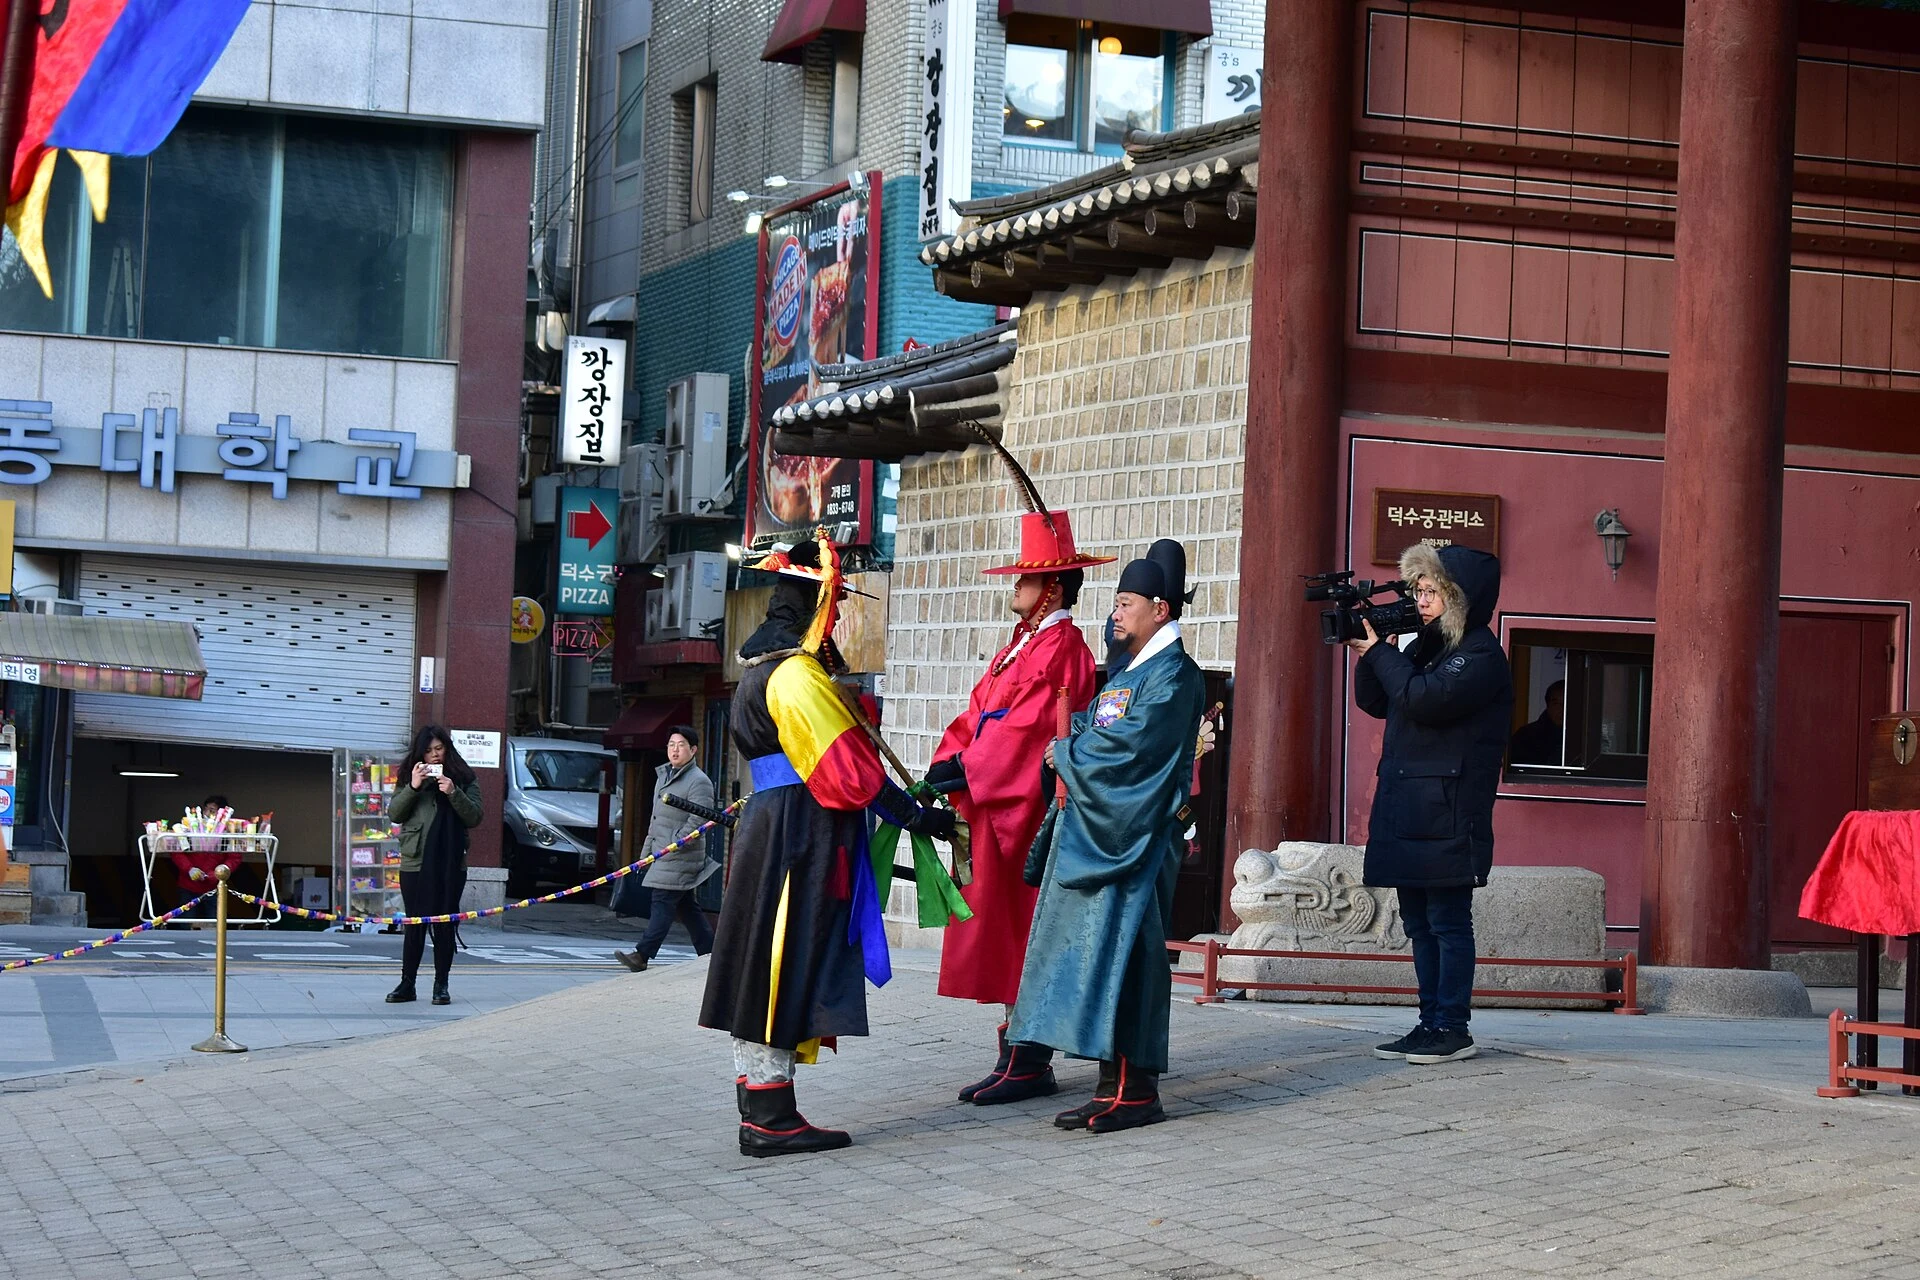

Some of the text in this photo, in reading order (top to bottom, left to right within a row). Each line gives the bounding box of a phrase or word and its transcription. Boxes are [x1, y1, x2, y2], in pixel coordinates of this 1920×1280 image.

[774, 245, 800, 289] CHICAGO
[770, 258, 807, 320] MADE IN
[779, 297, 800, 333] PIZZA
[575, 346, 613, 454] 깡장집
[1388, 506, 1485, 529] 덕수궁관리소
[562, 587, 609, 605] PIZZA
[556, 628, 599, 649] PIZZA
